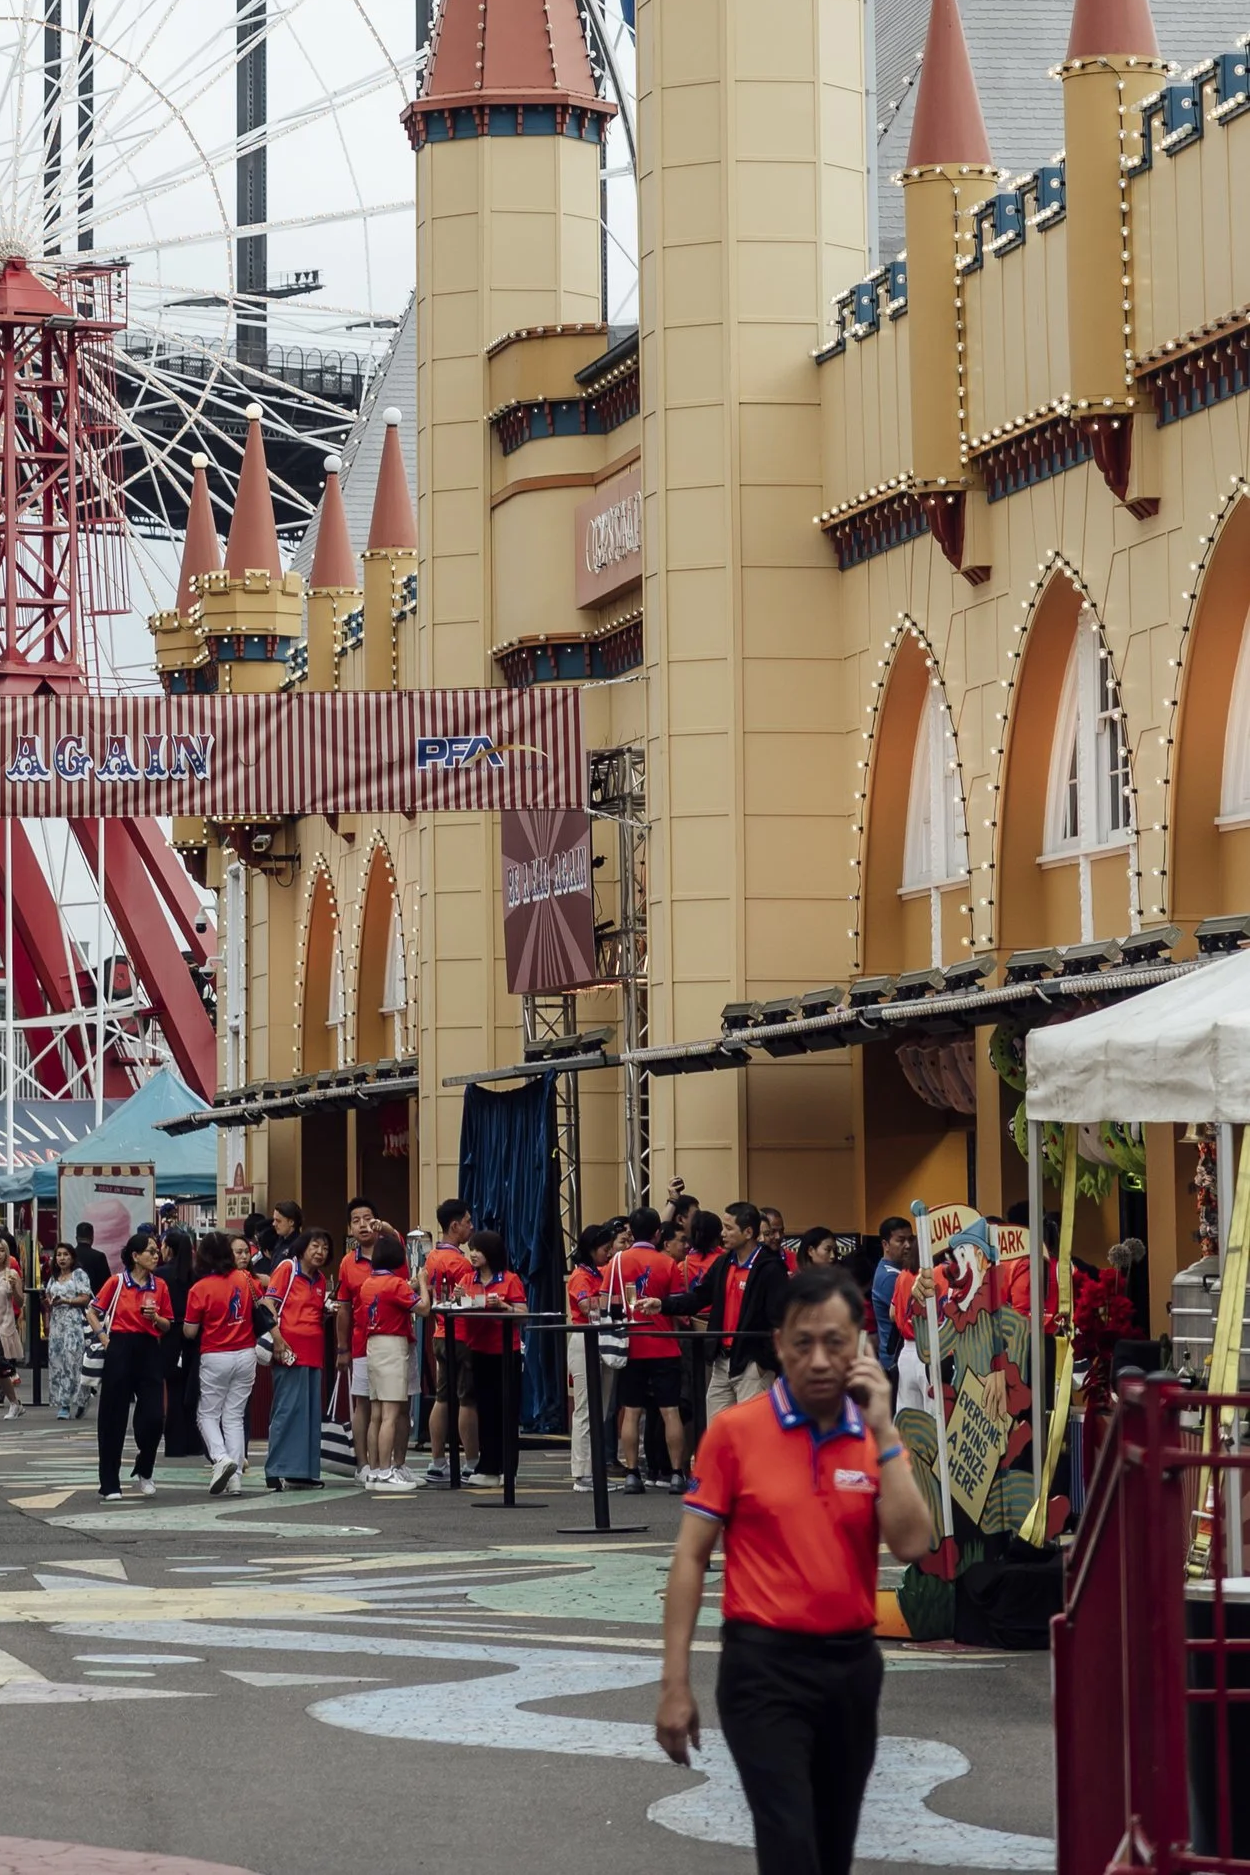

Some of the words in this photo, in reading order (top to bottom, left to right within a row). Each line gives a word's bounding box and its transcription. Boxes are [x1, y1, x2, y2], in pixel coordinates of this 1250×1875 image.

[5, 733, 214, 782] AGAIN
[416, 735, 505, 770] PFA
[553, 845, 587, 897] AGAIN
[959, 1390, 1003, 1449] EVERYONE
[961, 1416, 988, 1459] WINS
[947, 1431, 958, 1451] A
[958, 1440, 988, 1484] PRIZE
[948, 1455, 979, 1501] HERE
